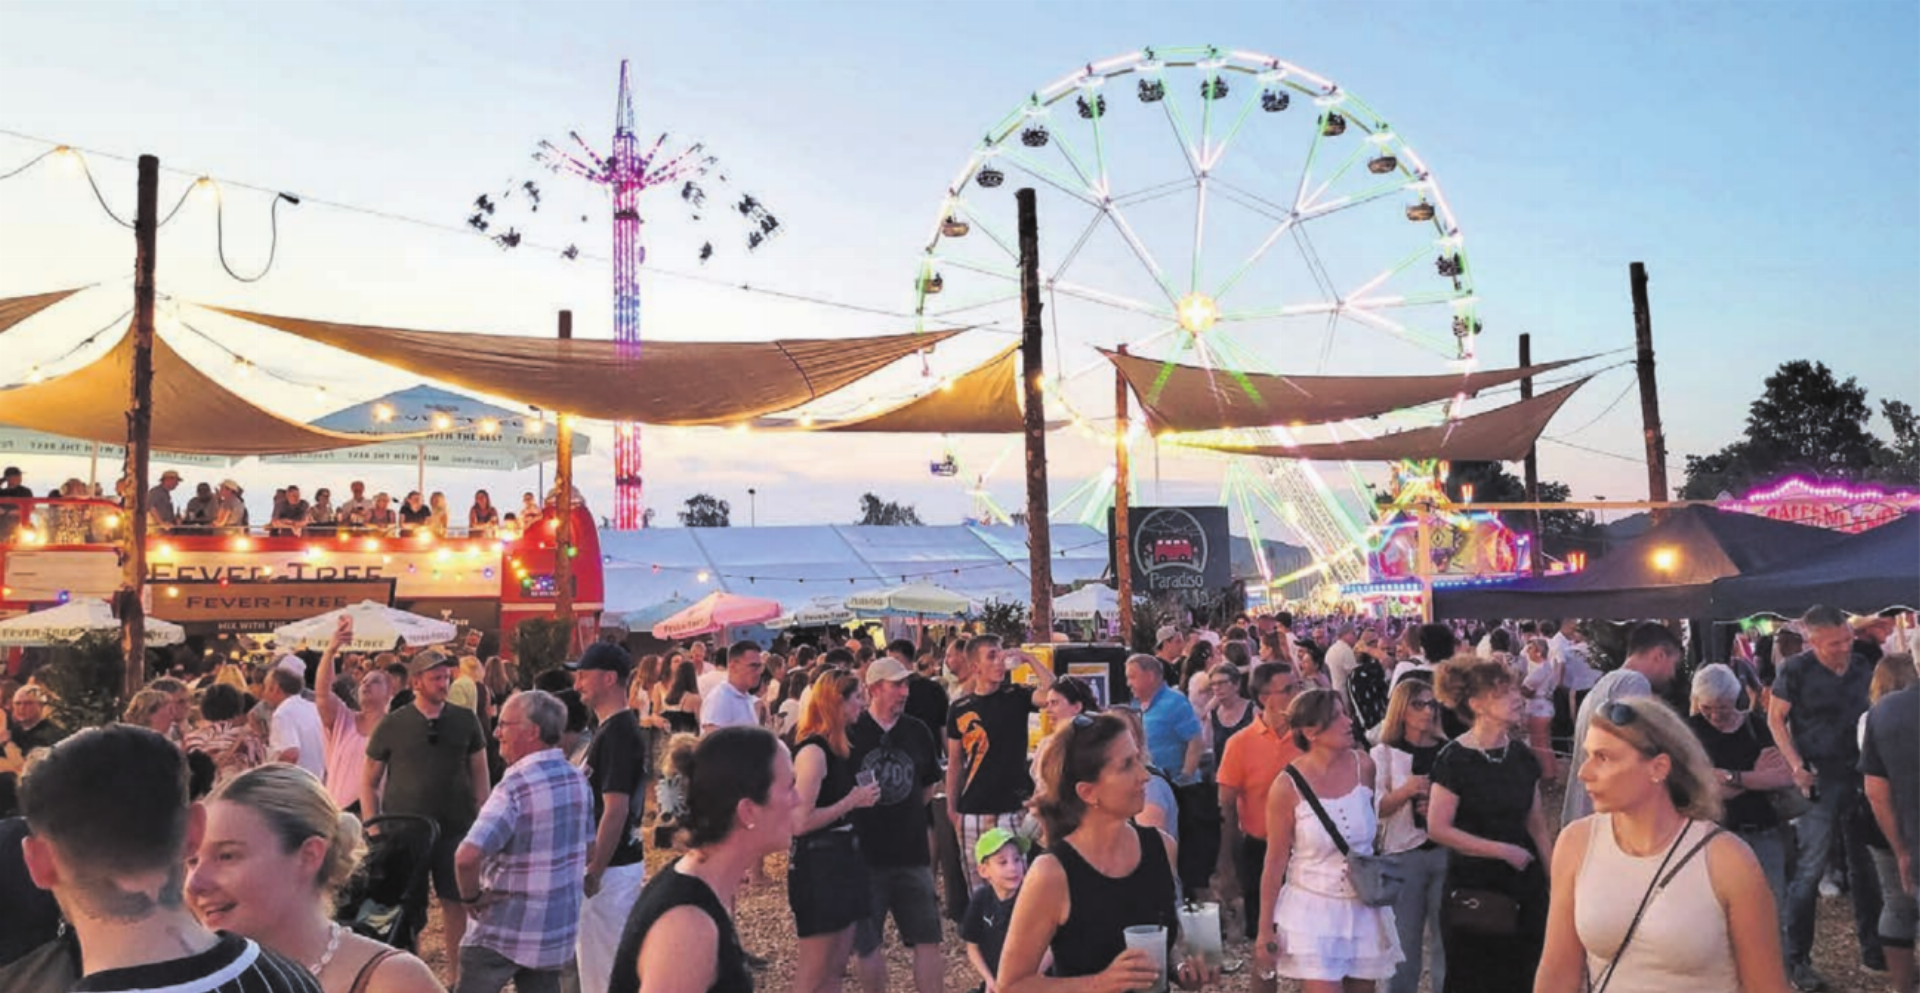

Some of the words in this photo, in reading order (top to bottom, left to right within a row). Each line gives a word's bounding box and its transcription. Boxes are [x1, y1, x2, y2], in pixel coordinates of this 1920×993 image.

[457, 433, 475, 441] THE
[1149, 573, 1204, 588] Paradiso
[186, 595, 347, 609] FEVER-TREE
[240, 621, 266, 630] WITH
